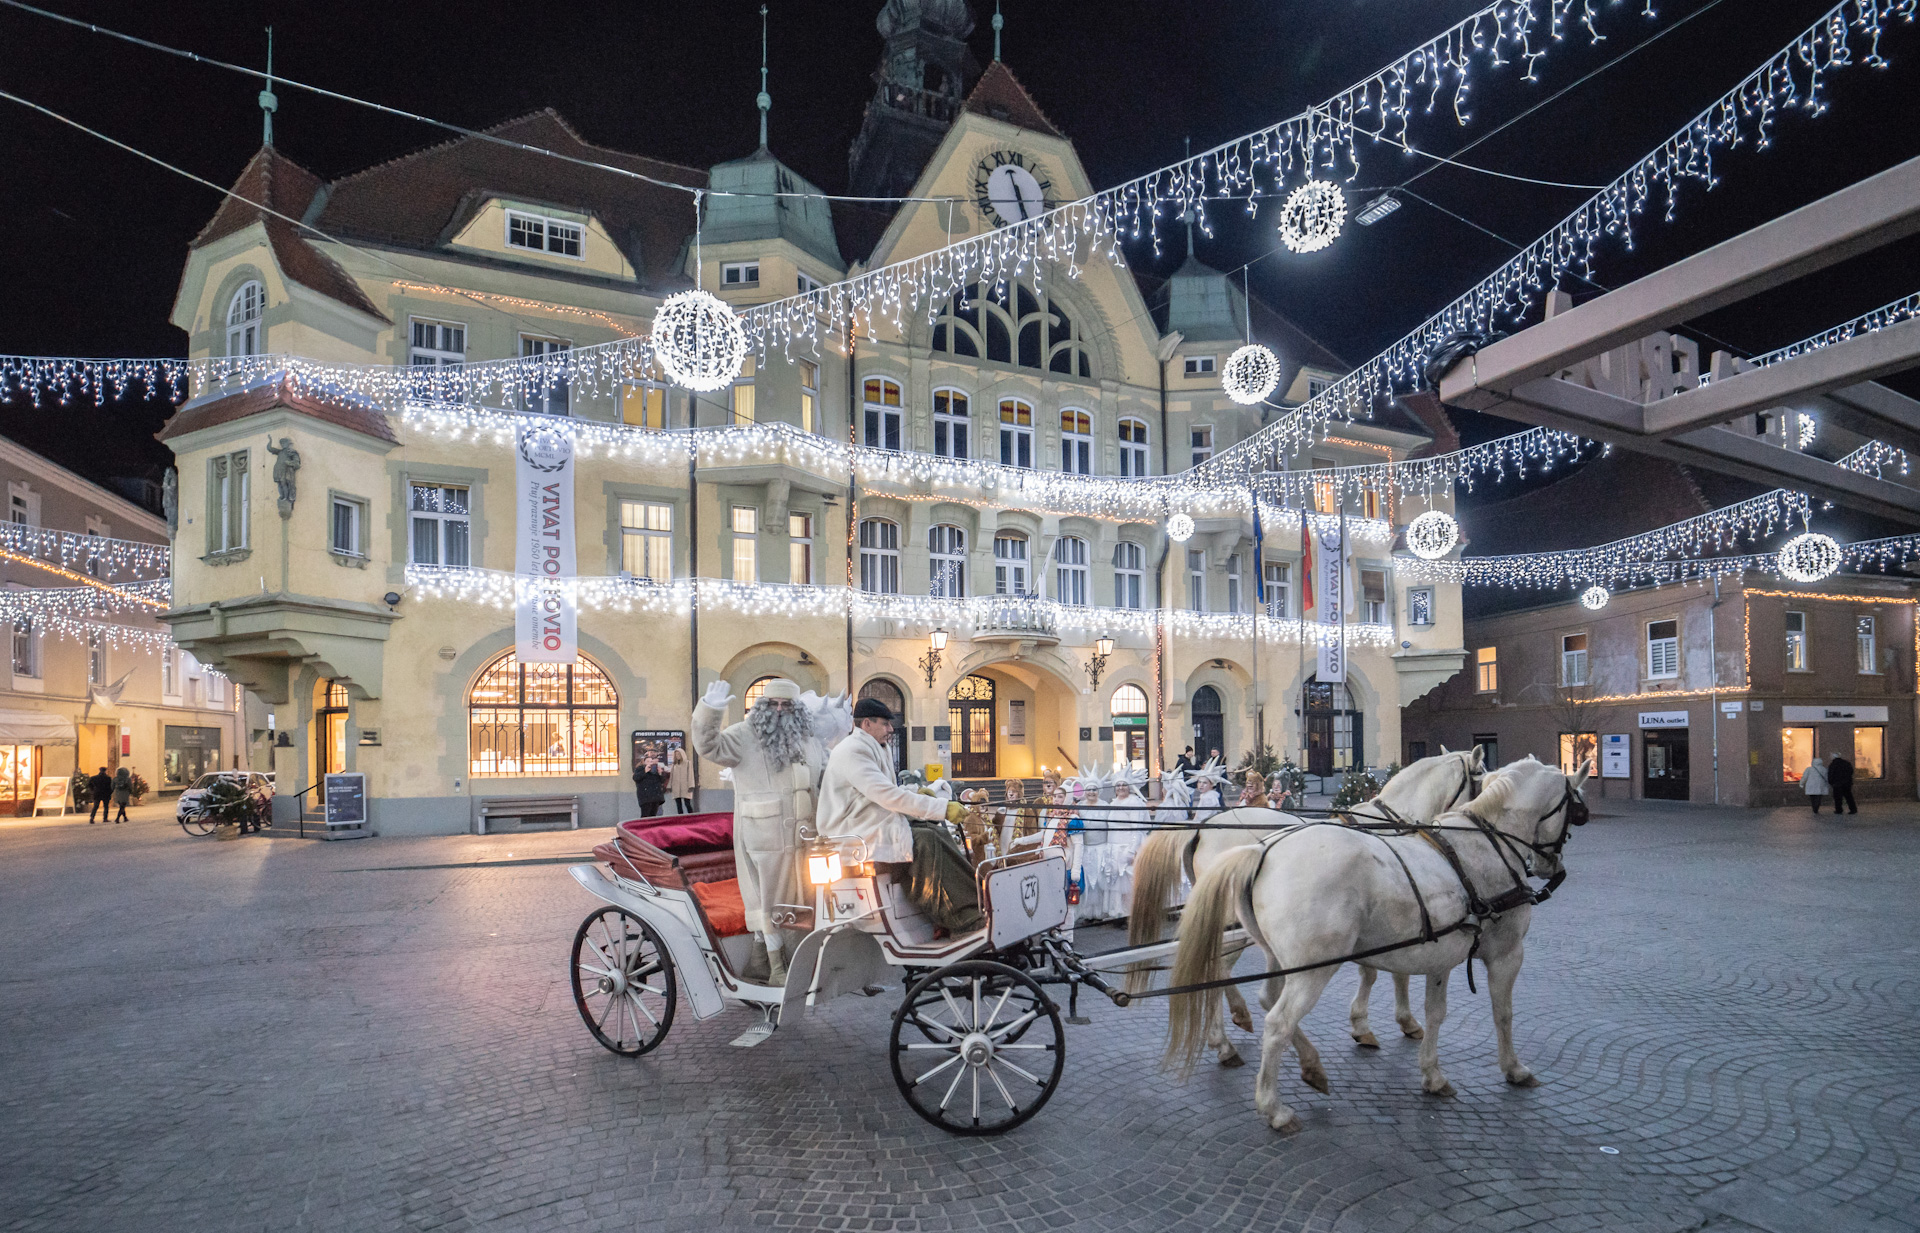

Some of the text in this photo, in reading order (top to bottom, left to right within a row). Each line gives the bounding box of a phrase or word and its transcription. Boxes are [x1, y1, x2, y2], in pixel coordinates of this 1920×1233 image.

[1008, 150, 1023, 167] XII
[529, 481, 541, 499] Ptuj
[529, 499, 541, 536] praznuje
[542, 482, 560, 541] VIVAT
[531, 538, 541, 560] 1950
[531, 561, 541, 572] let
[1330, 559, 1339, 599] VIVAT
[531, 616, 541, 650] omembe
[1641, 716, 1665, 725] LUNA
